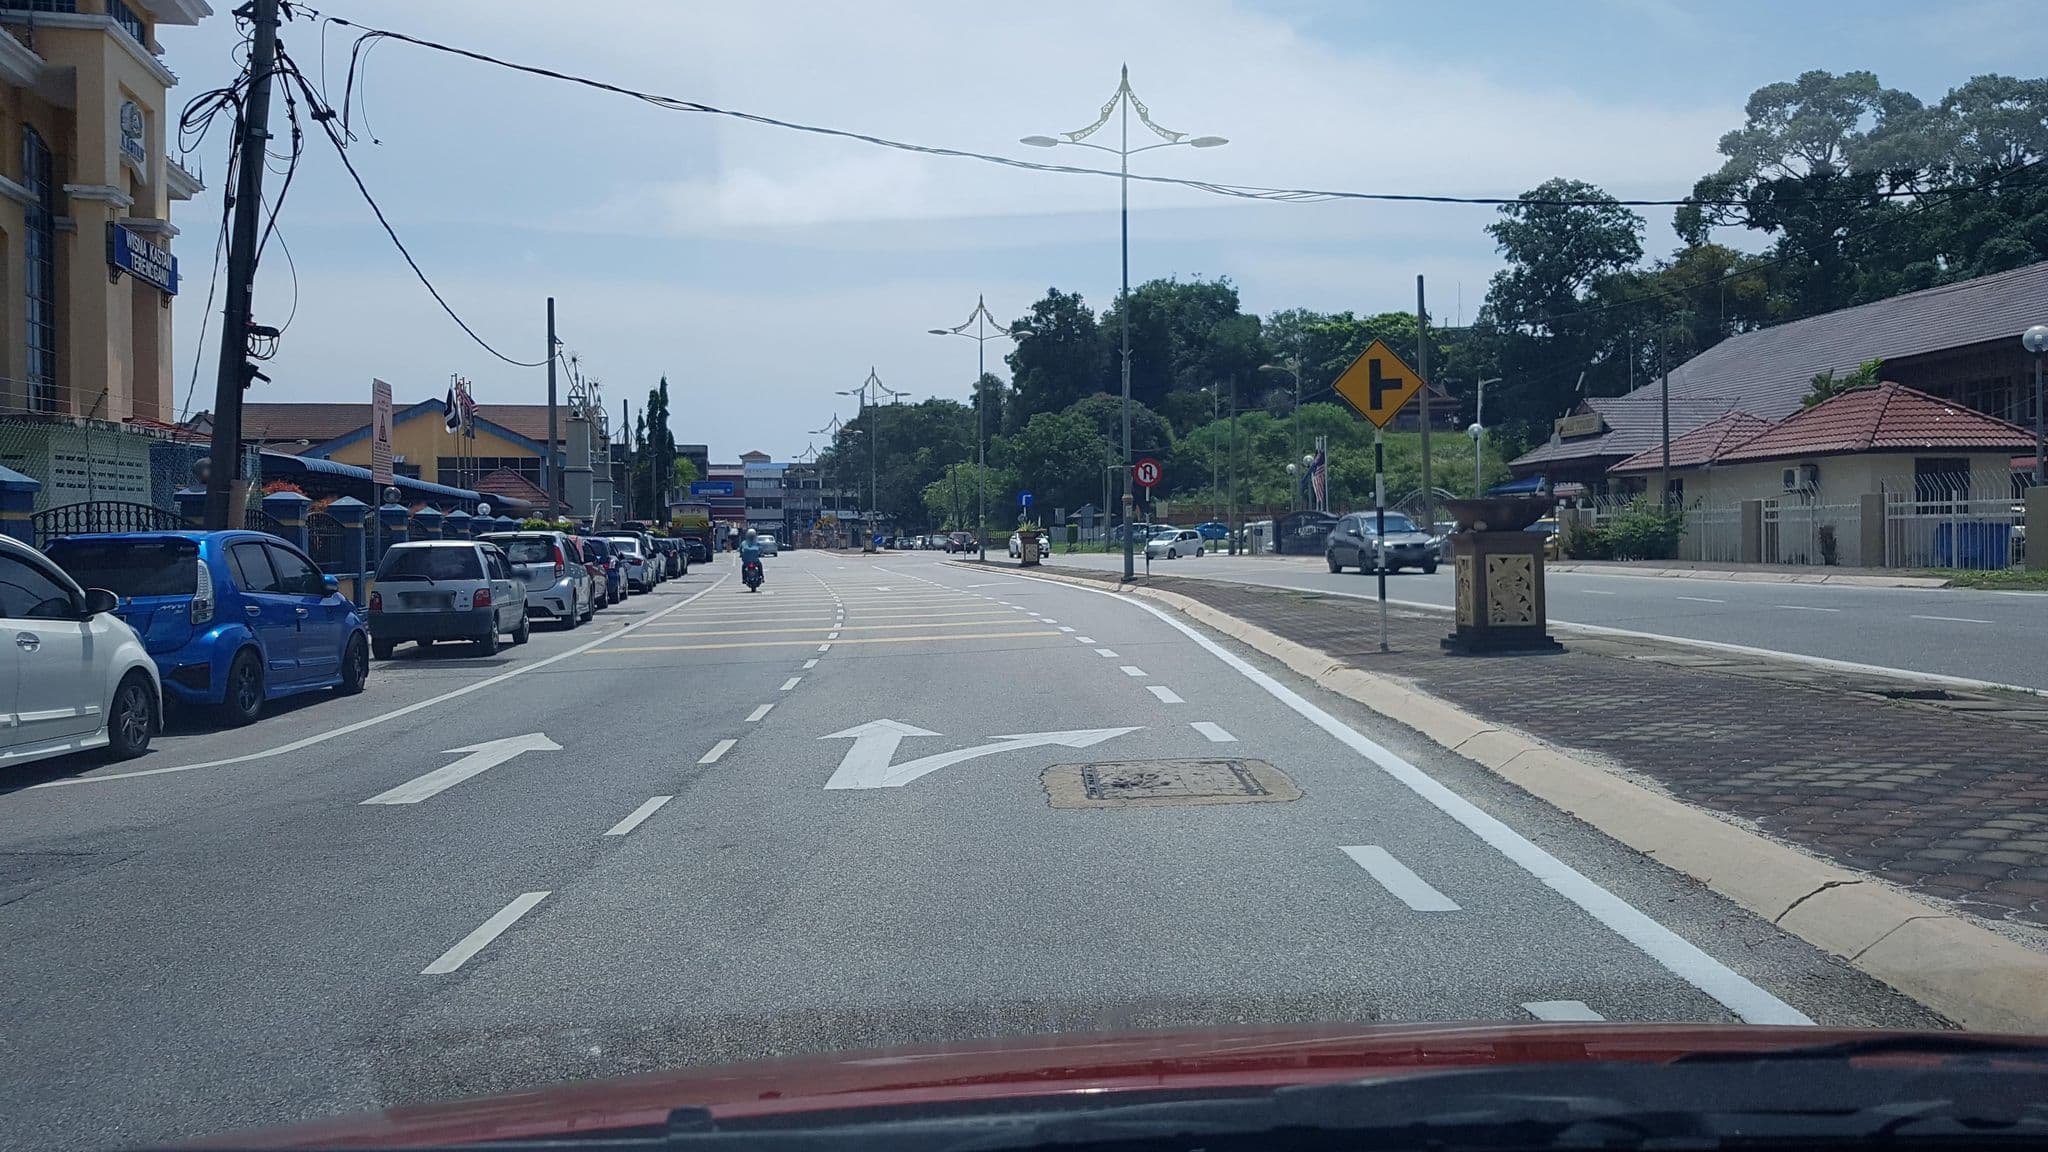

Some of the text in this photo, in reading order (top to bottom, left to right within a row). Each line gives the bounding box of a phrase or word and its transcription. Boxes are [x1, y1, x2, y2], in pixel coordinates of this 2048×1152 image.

[126, 230, 173, 271] WISMA KASTAM
[130, 251, 169, 286] TERENGGANU
